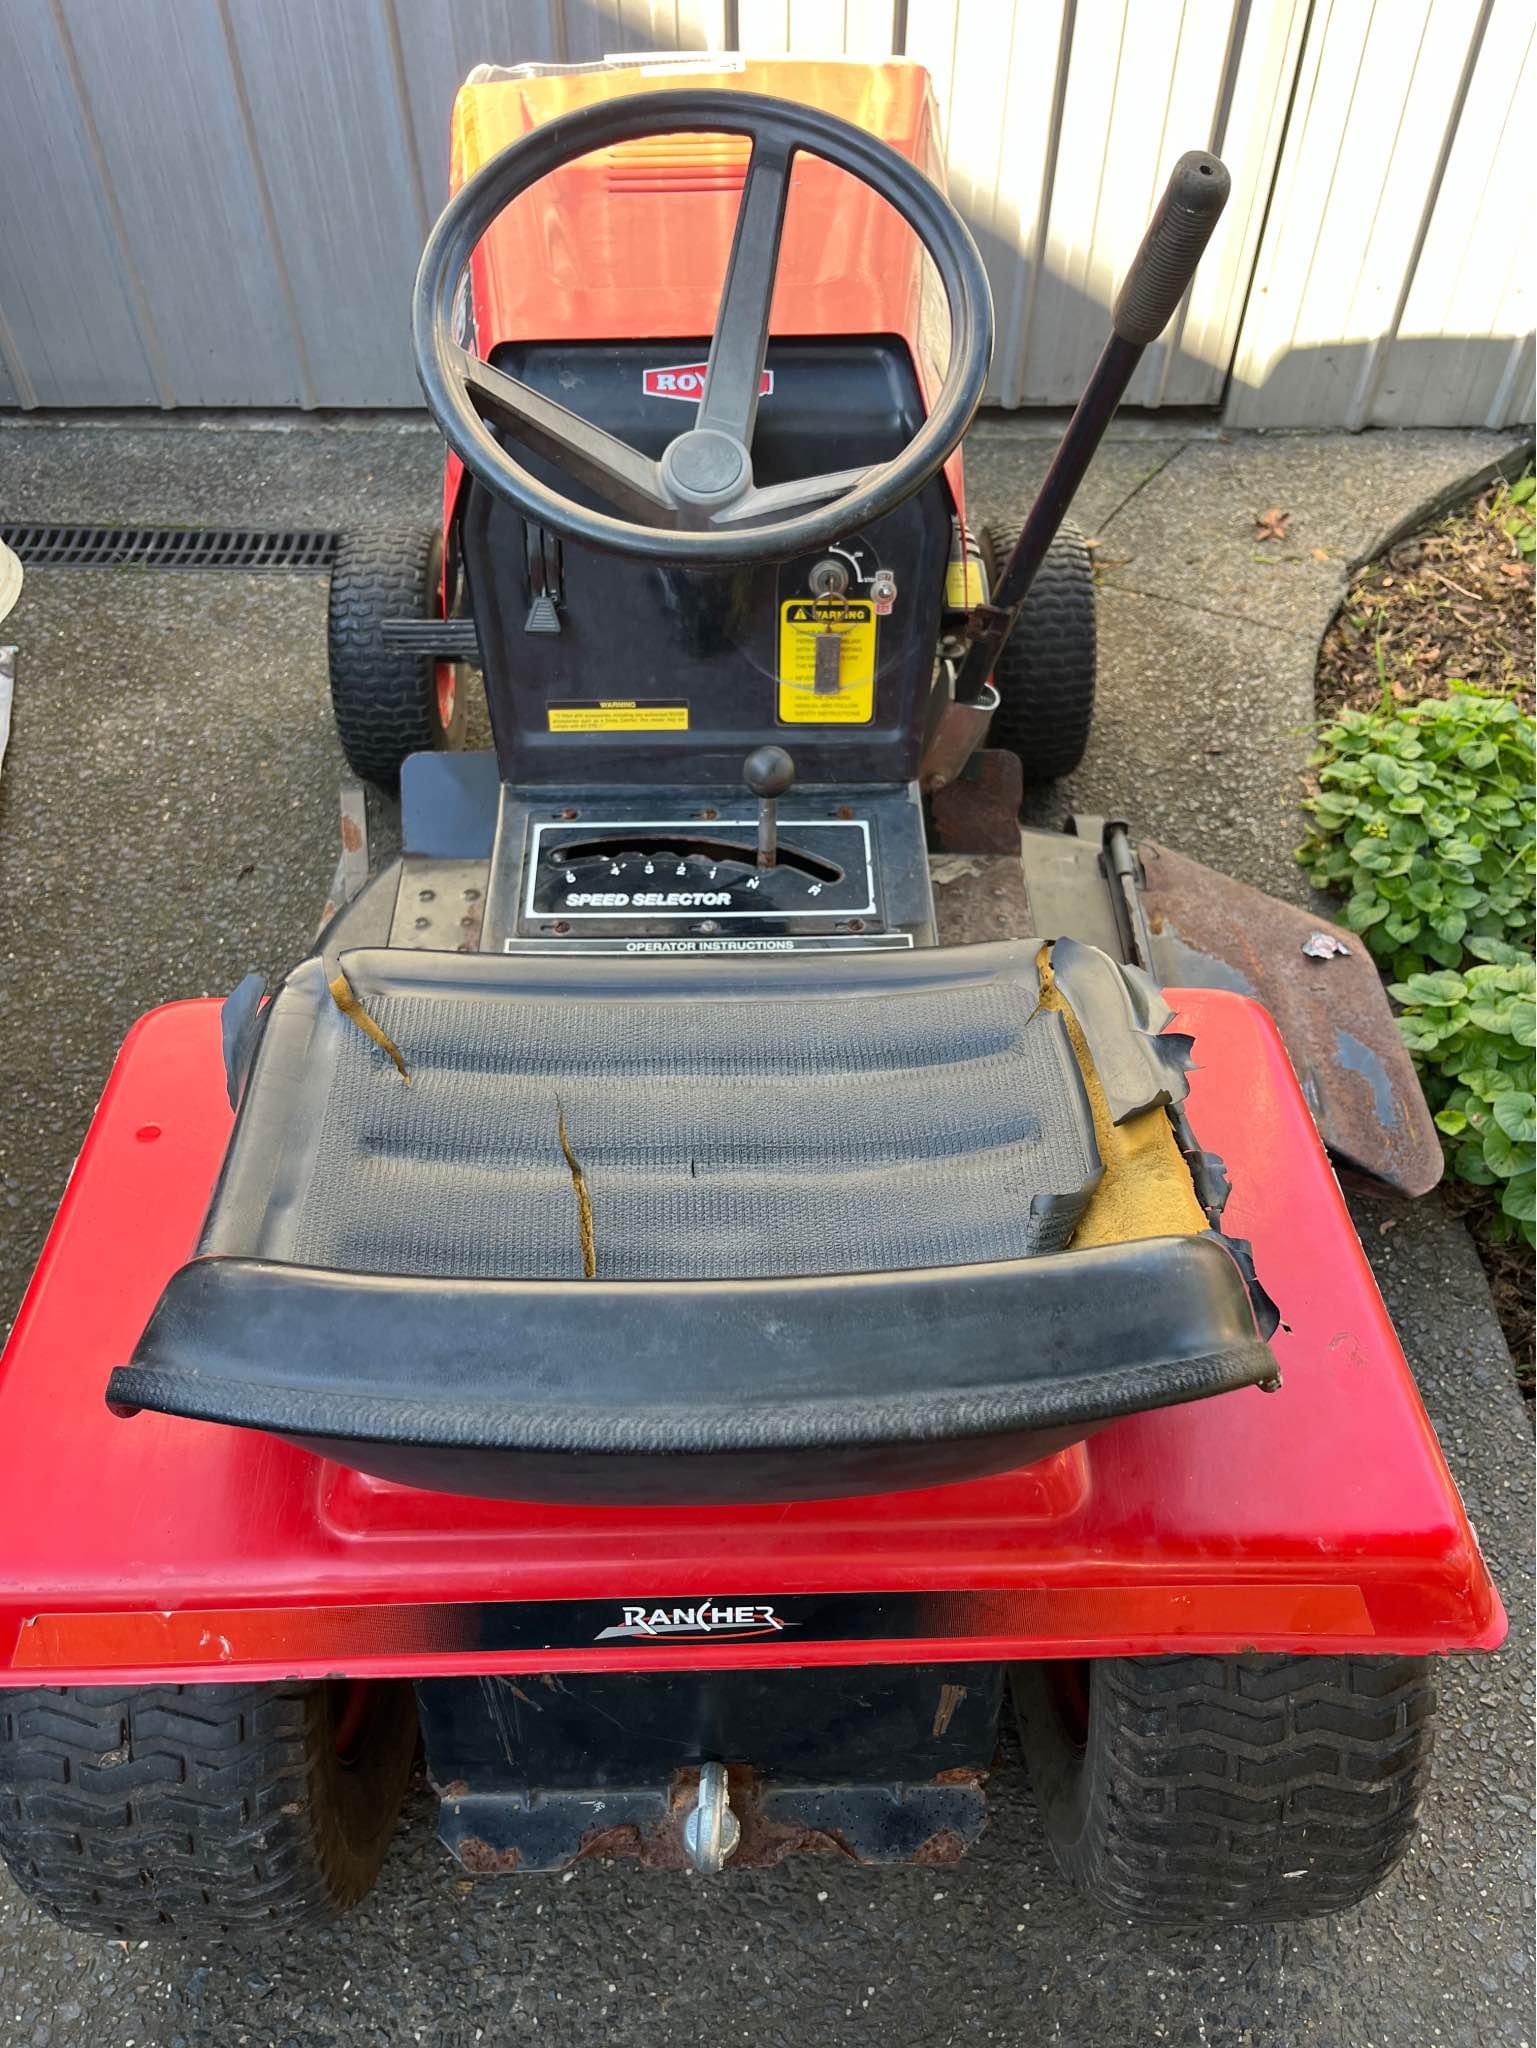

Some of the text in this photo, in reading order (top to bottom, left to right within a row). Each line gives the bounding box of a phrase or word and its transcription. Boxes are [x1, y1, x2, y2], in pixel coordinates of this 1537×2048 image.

[610, 865, 621, 876] 4
[644, 864, 655, 875] 3
[675, 865, 687, 876] 2
[746, 877, 760, 890] N
[807, 885, 822, 897] R
[565, 892, 732, 907] SPEED SELECTOR
[626, 940, 794, 951] OPERATOR INSTRUCTIONS
[622, 1600, 784, 1635] RANCHER
